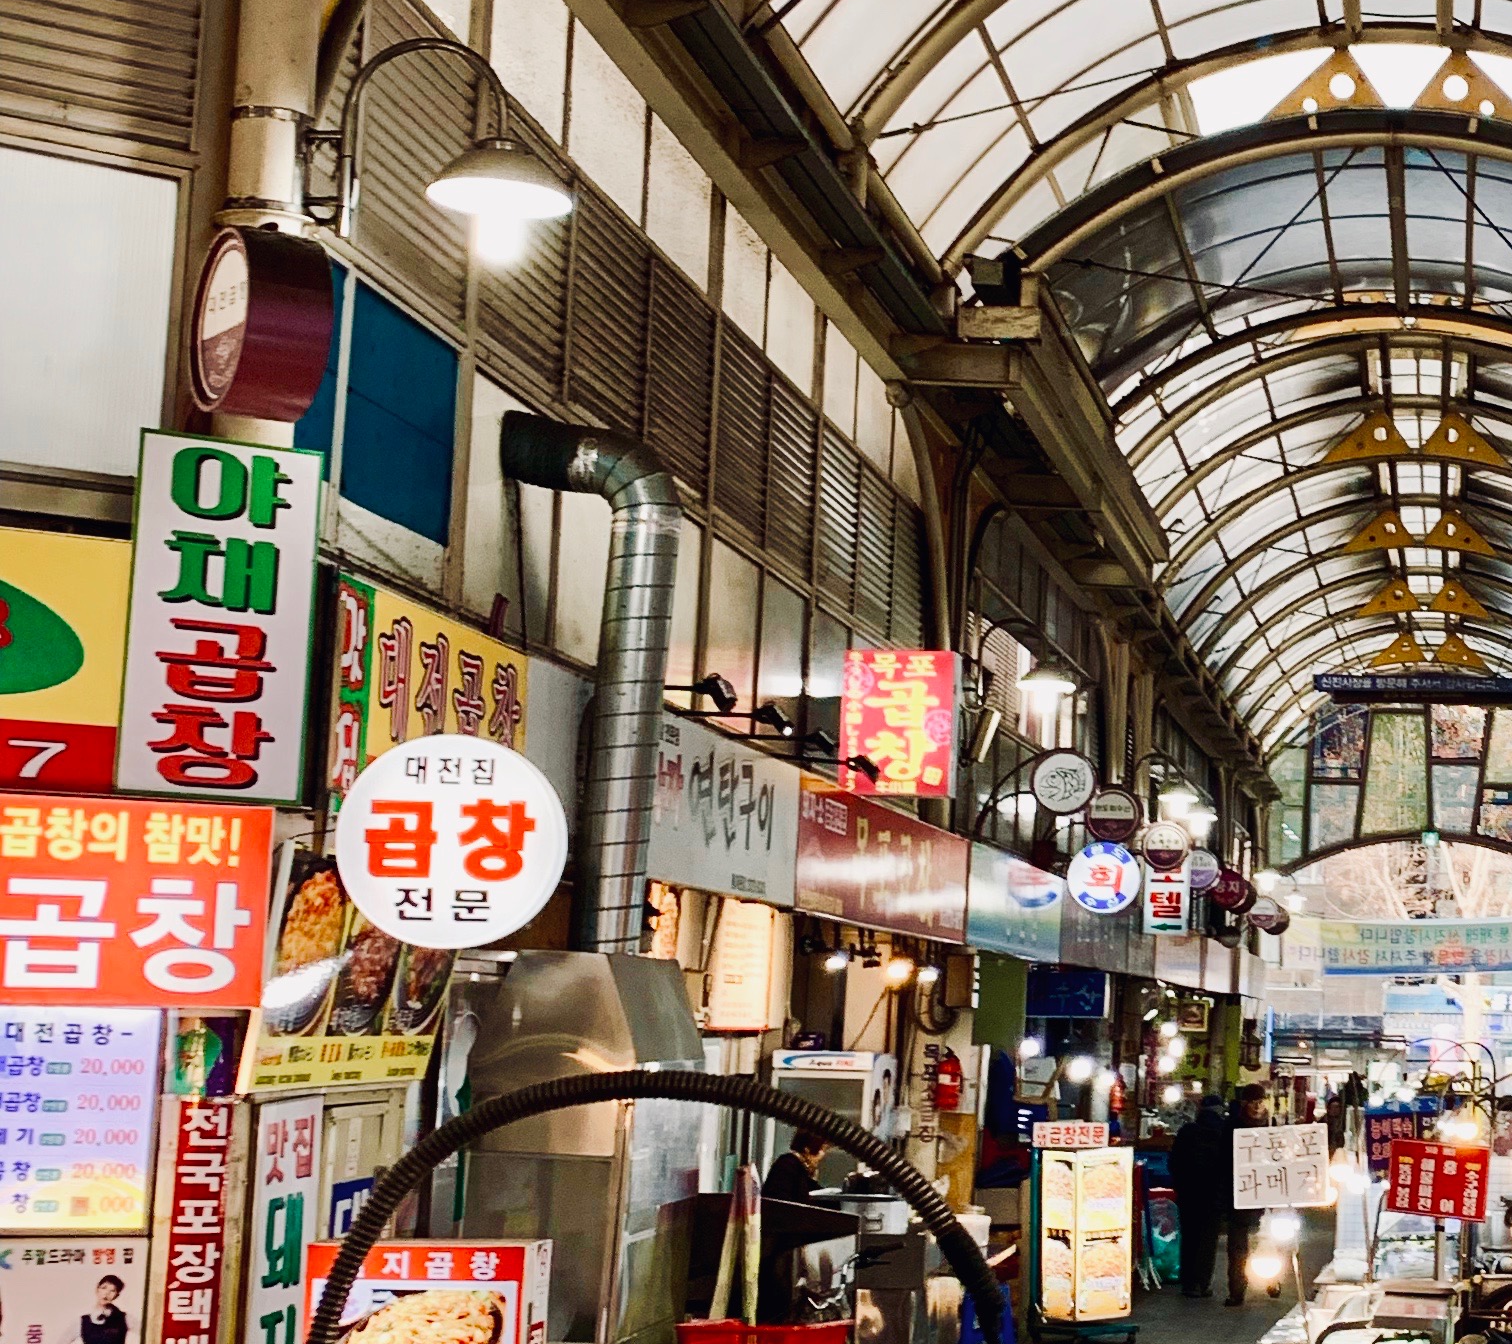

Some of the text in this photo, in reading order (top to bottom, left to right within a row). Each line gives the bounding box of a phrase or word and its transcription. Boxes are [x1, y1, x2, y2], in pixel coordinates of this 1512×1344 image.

[147, 446, 291, 790] 야채곱창
[8, 740, 67, 778] 7
[405, 756, 496, 784] 대전집
[688, 747, 776, 852] 연탄구이
[0, 808, 241, 868] 곱창의 참맛!
[365, 797, 536, 882] 곱창
[1083, 863, 1124, 897] 회
[395, 887, 492, 922] 전문
[1, 878, 253, 994] 곱창
[6, 1022, 113, 1046] 대전곱창
[264, 1113, 316, 1186] 맛집
[1238, 1130, 1323, 1159] 구룡포
[1237, 1163, 1321, 1199] 과메기
